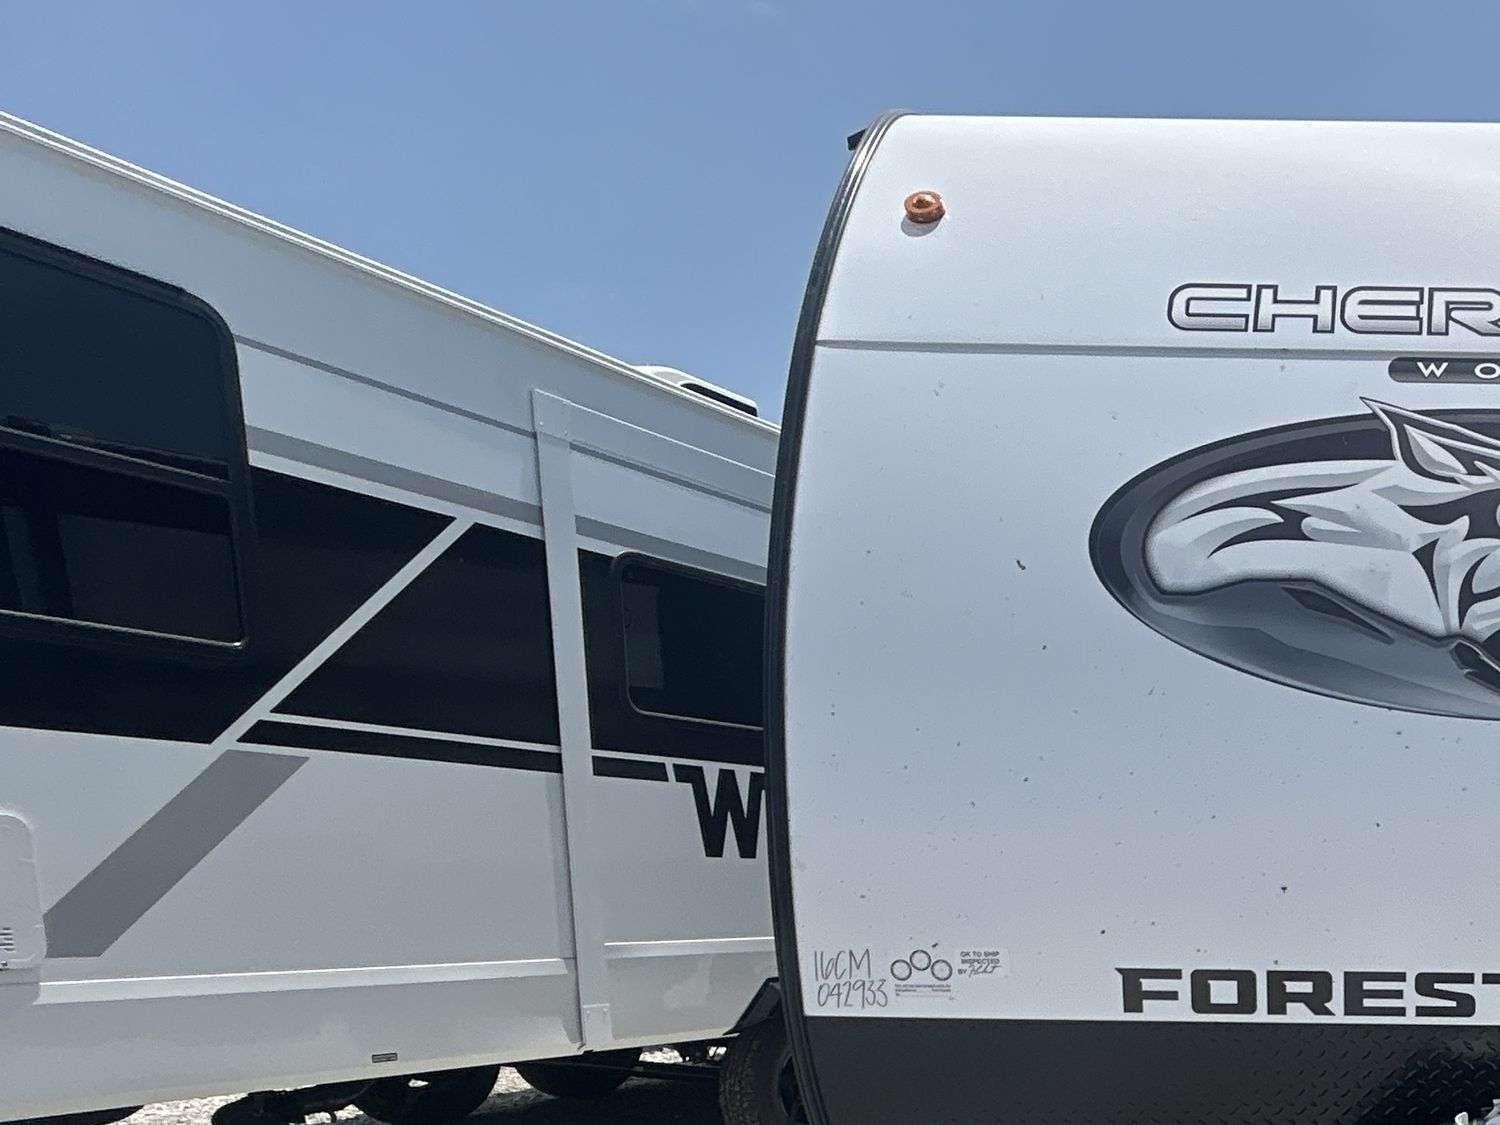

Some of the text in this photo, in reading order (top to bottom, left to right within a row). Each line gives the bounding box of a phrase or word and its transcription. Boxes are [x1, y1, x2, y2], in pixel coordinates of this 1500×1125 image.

[814, 948, 871, 981] 16CM
[960, 950, 971, 958] OK
[817, 978, 889, 1009] 042933
